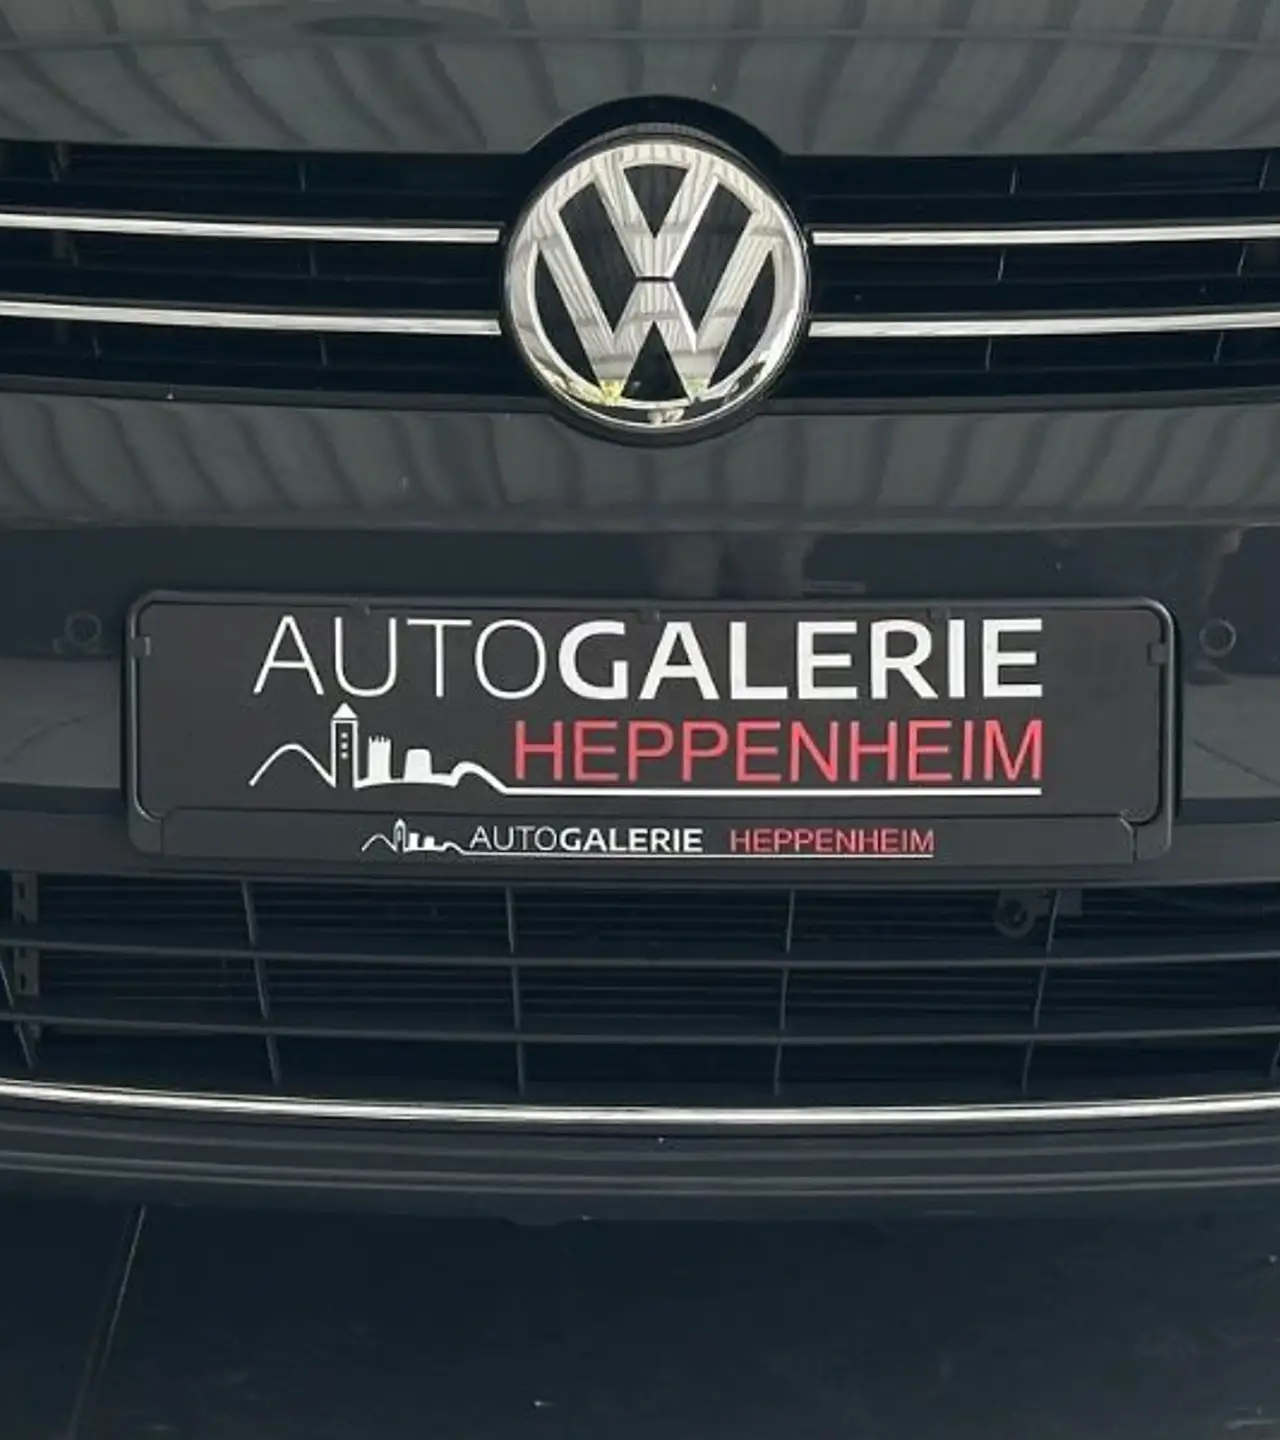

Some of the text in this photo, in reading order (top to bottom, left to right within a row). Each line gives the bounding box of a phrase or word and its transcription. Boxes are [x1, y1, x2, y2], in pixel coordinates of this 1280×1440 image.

[252, 614, 1043, 701] AUTOGALERIE
[514, 718, 1043, 782] HEPPENHEIM
[469, 824, 935, 854] AUTOGALERIE HEPPENHEIM
